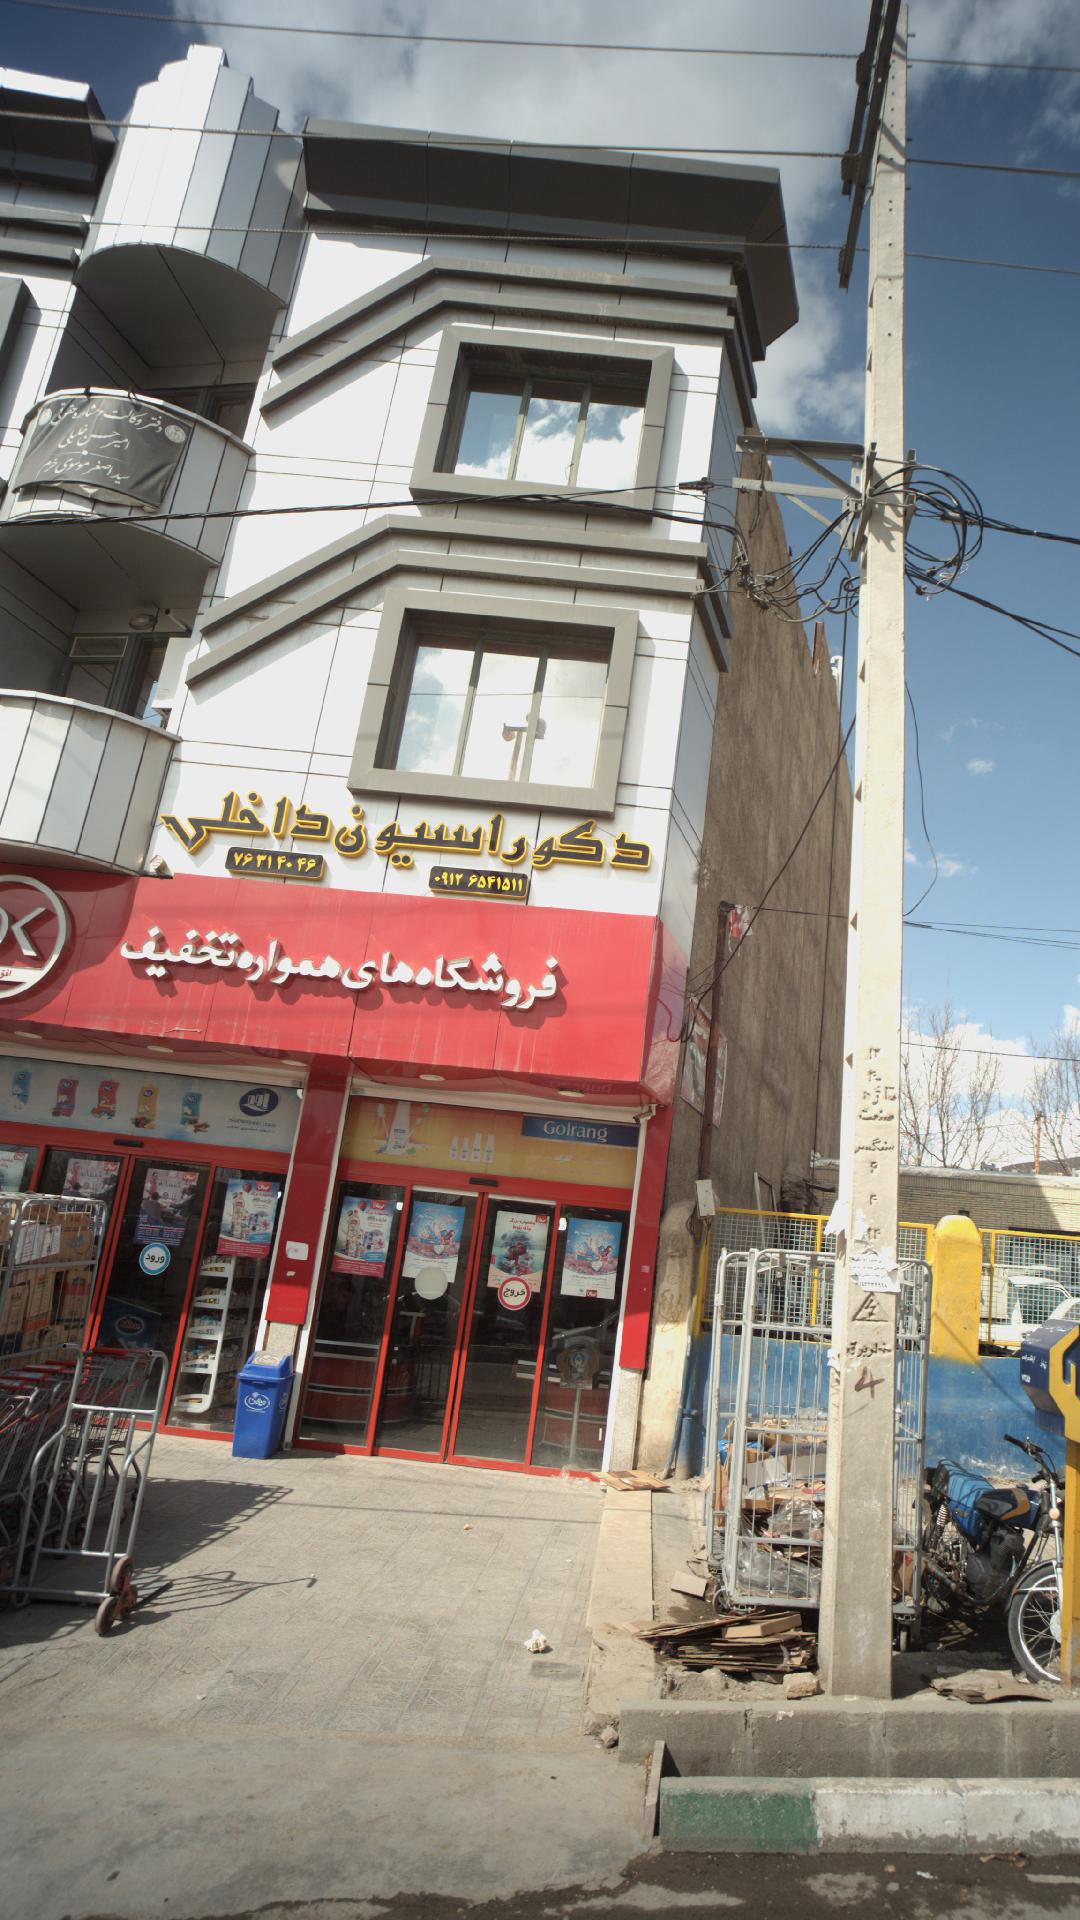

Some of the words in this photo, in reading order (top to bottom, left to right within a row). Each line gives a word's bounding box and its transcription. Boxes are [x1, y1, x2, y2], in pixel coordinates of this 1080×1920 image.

[160, 790, 331, 855] داخلی
[332, 804, 652, 870] دکوراسیون
[0, 904, 47, 957] K
[119, 924, 240, 979] تخفیف
[543, 1120, 608, 1143] Golrang
[145, 1254, 165, 1264] ورود
[503, 1286, 526, 1297] خروج
